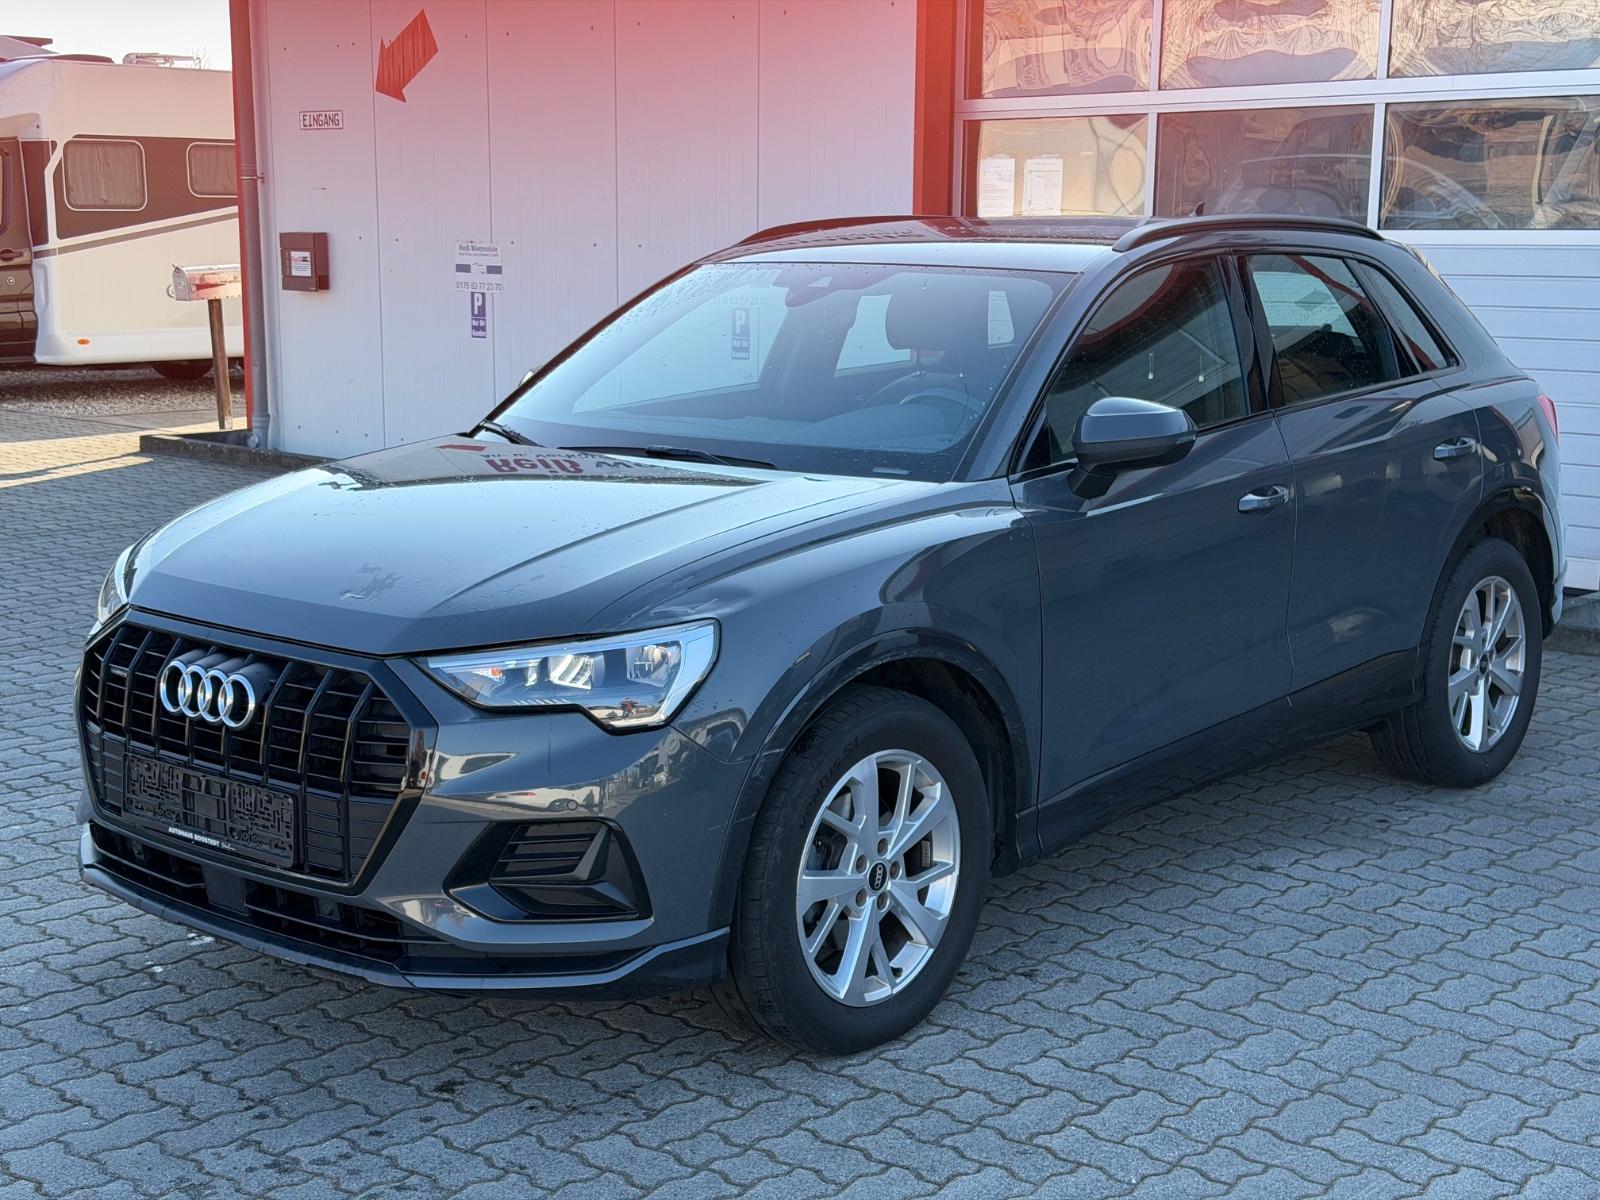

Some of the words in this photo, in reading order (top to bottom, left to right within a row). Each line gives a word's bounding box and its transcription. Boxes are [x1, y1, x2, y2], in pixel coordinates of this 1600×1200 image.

[303, 113, 340, 127] EINGANG
[473, 292, 483, 315] P
[735, 310, 746, 334] P
[168, 826, 194, 839] AUTOHAUS
